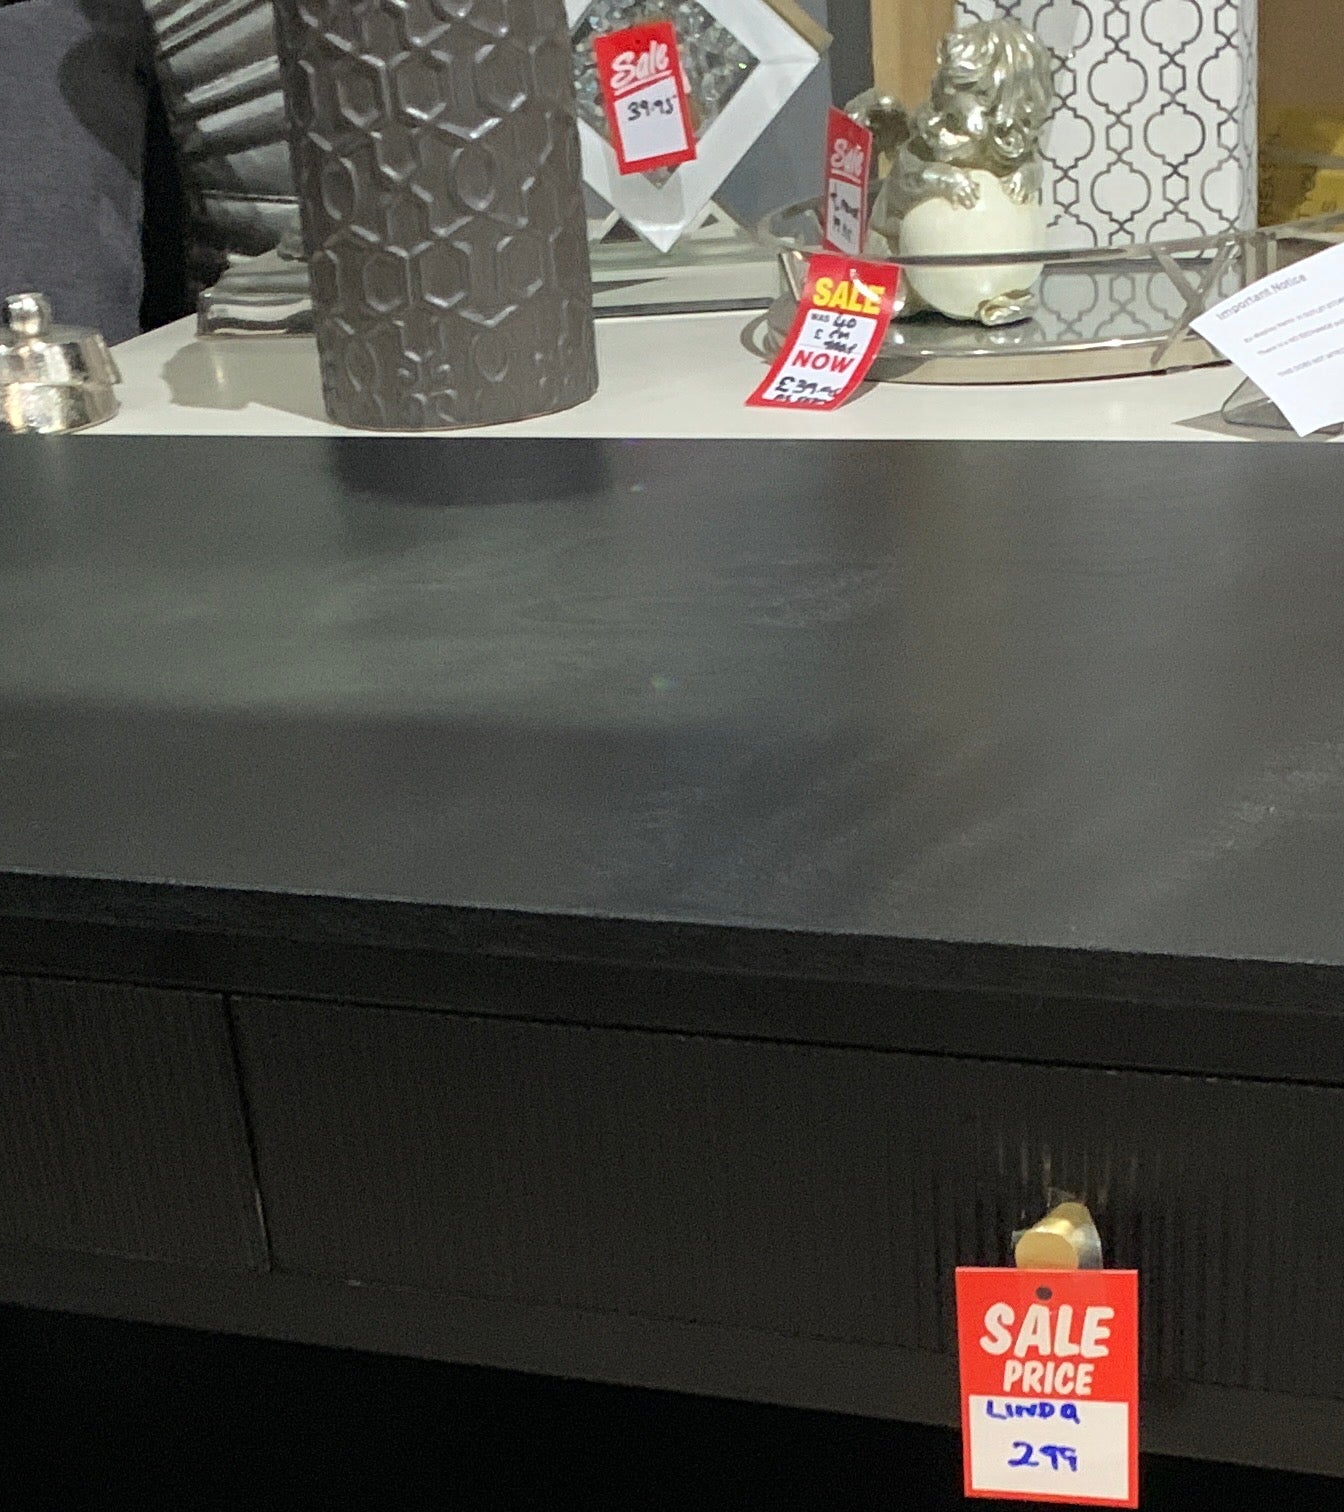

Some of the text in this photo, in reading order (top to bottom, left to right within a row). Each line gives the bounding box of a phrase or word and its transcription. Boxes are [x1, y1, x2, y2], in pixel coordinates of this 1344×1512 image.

[610, 39, 669, 90] Sale
[812, 276, 886, 315] SALE
[1216, 273, 1308, 321] Important Notice
[792, 350, 855, 373] NOW
[979, 1301, 1115, 1359] SALE
[1003, 1360, 1095, 1395] PRICE
[1008, 1441, 1077, 1472] 299
